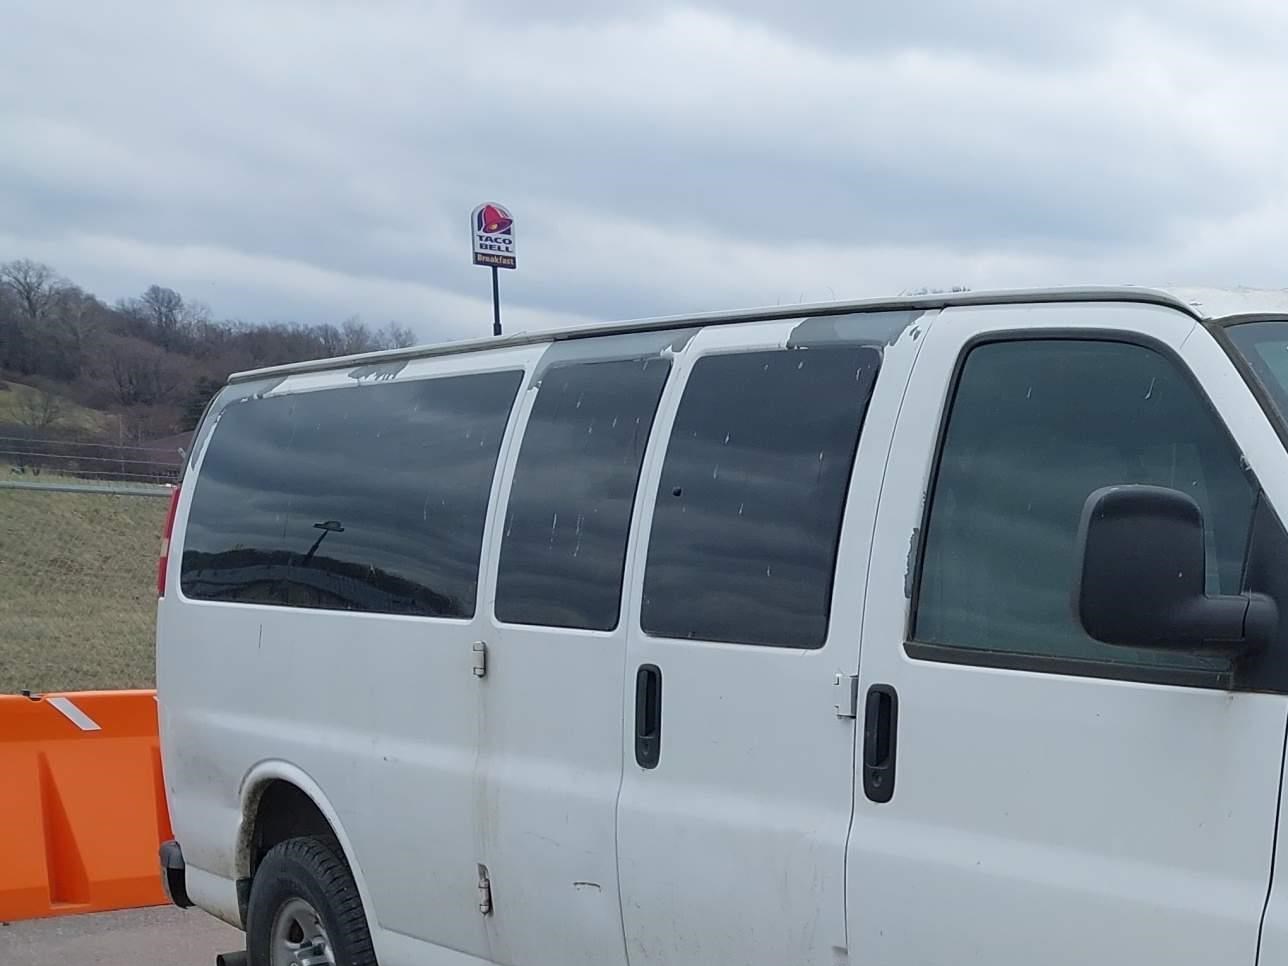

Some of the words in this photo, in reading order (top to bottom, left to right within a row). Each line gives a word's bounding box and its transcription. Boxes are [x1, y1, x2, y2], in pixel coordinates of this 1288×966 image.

[476, 235, 512, 245] TACO
[479, 243, 513, 253] BELL
[477, 254, 514, 265] Breakfast
